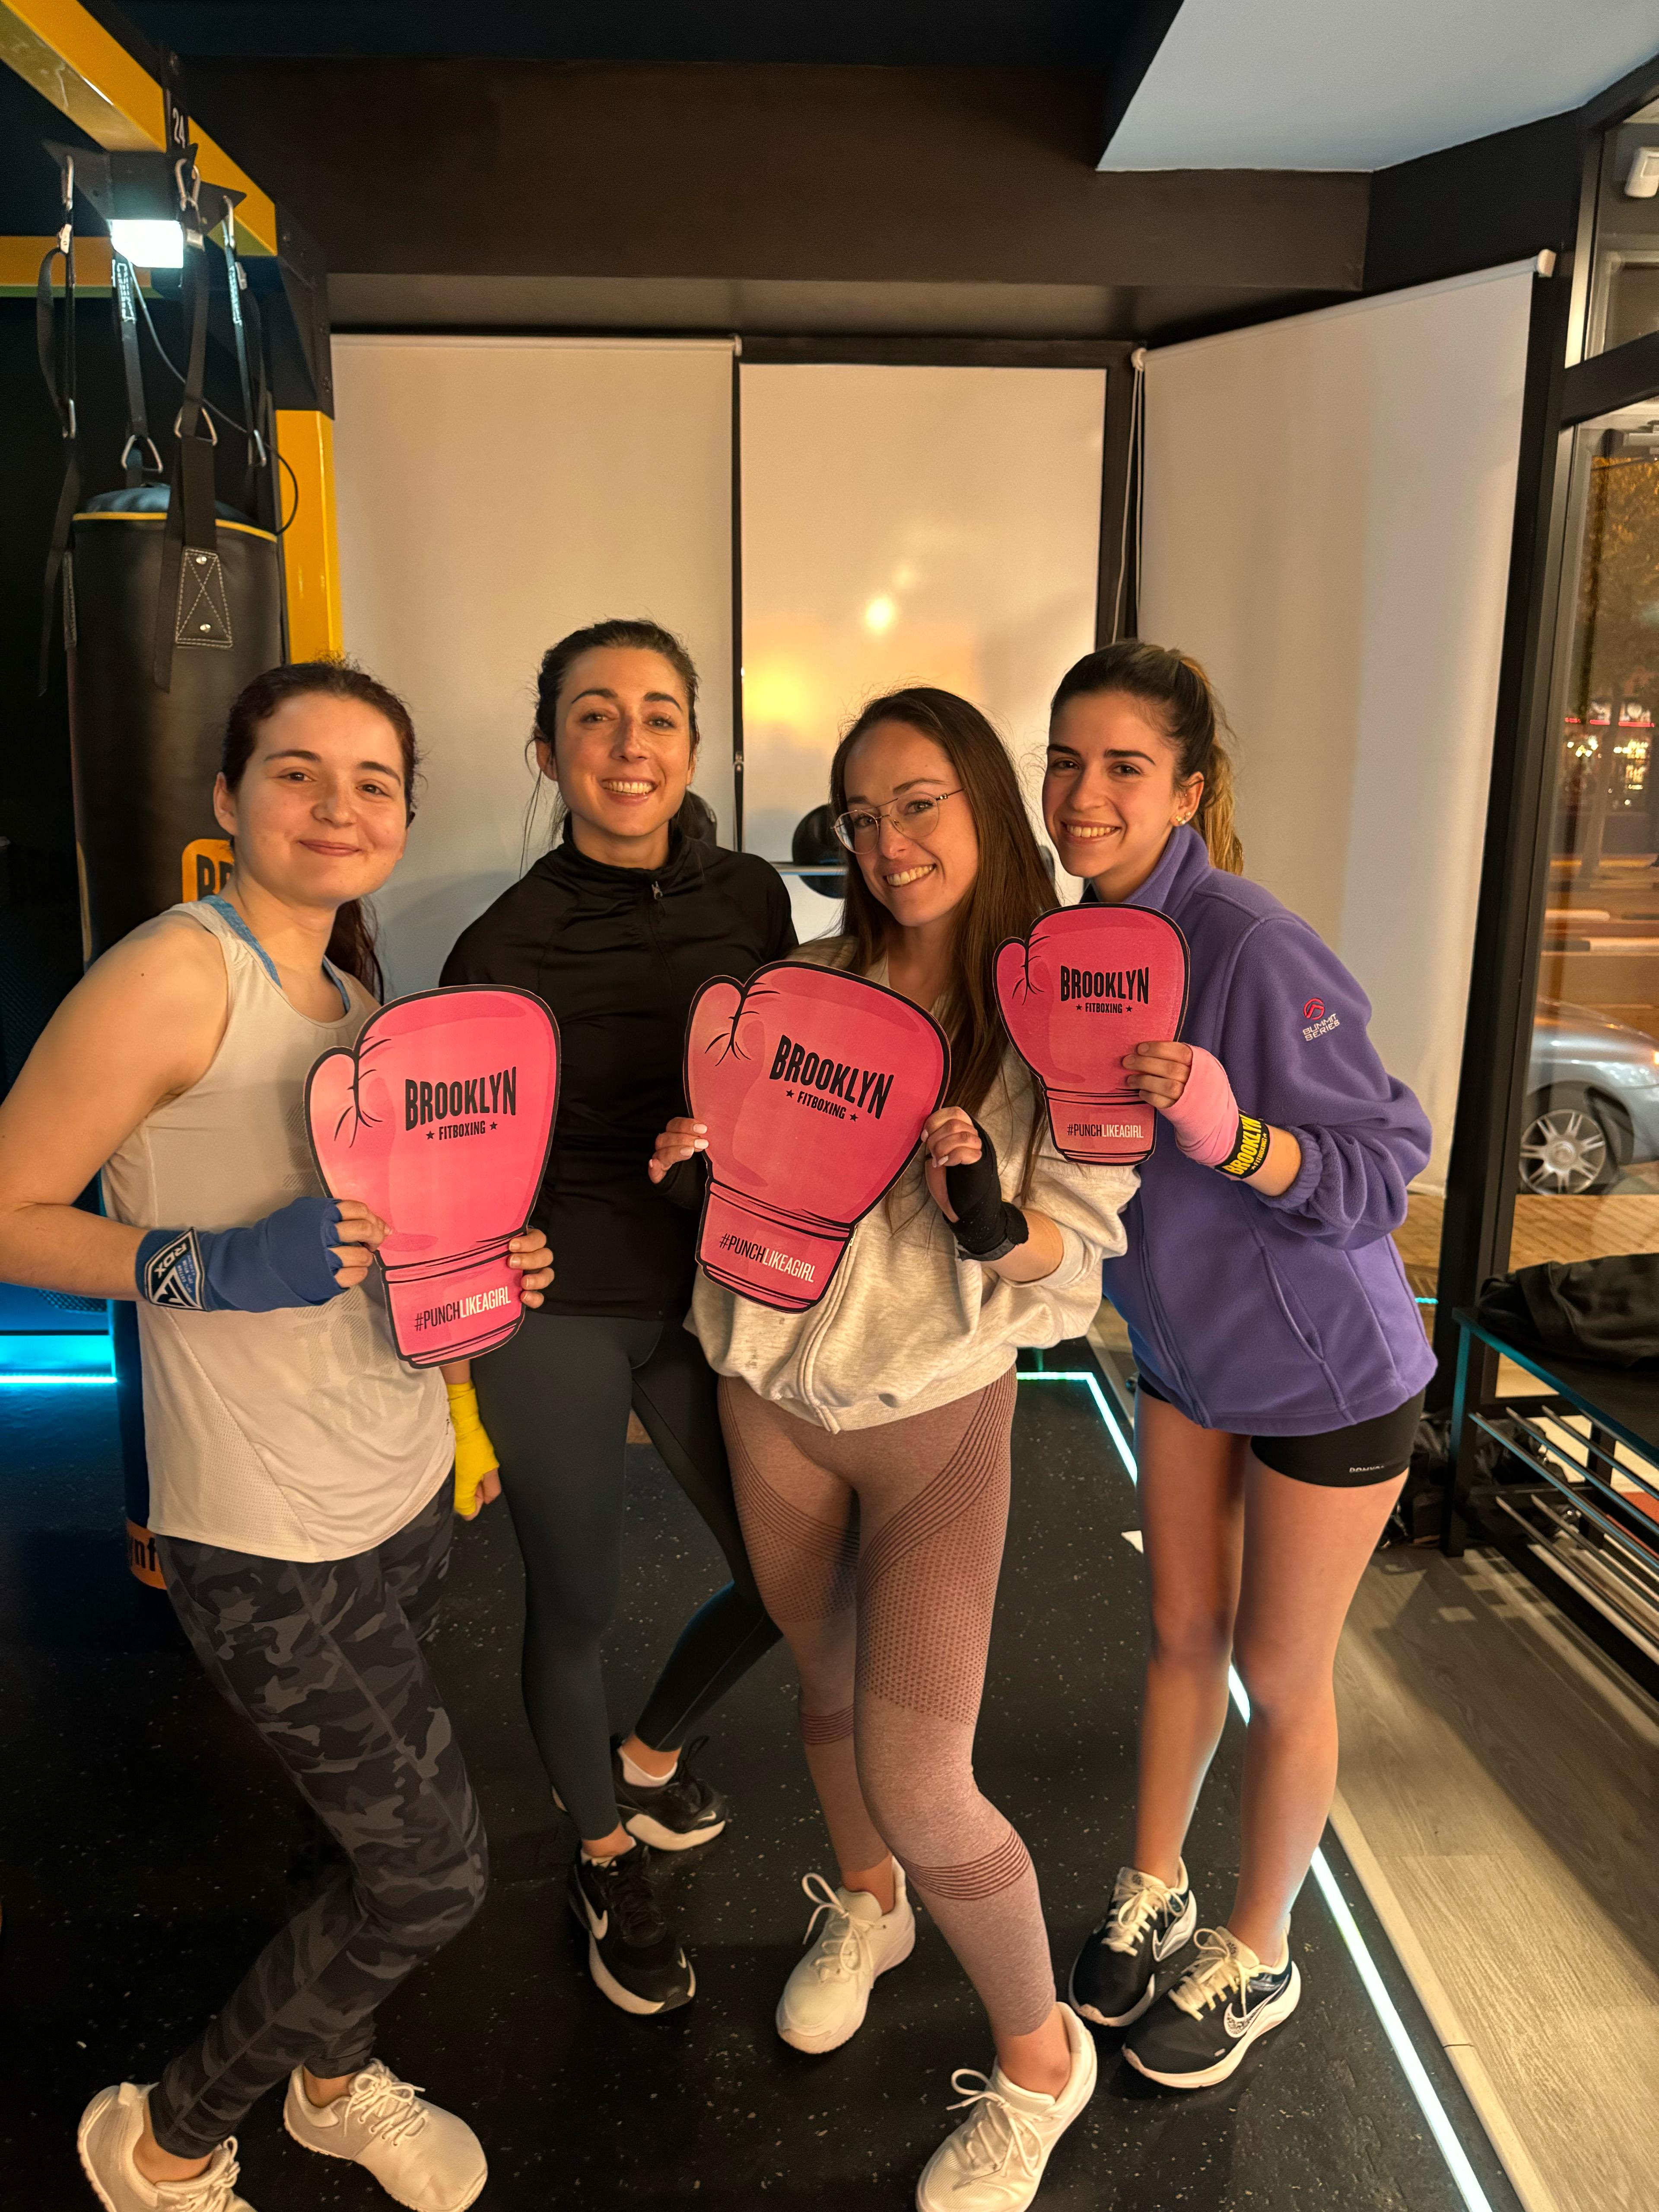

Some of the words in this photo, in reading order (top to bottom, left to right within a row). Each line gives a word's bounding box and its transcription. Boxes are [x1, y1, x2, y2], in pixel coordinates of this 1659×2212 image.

[173, 107, 186, 149] 24
[1060, 965, 1149, 1004] BROOKLYN
[1085, 1002, 1122, 1014] FITBOXING
[1303, 1013, 1336, 1035] SUMMIT
[1305, 1019, 1340, 1041] SERIES
[769, 1035, 894, 1119] BROOKLYN
[405, 1067, 516, 1131] BROOKLYN
[797, 1091, 846, 1119] FITBOXING
[439, 1120, 485, 1140] FITBOXING
[1067, 1124, 1144, 1138] #PUNCHLIKEAGIRL
[1222, 1113, 1262, 1175] BROOKLYN
[1254, 1137, 1267, 1166] FITBOXING
[154, 1243, 187, 1278] RDX
[719, 1233, 815, 1283] #PUNCHLIKEAGIRL
[414, 1286, 511, 1331] #PUNCHLIKEAGIRL
